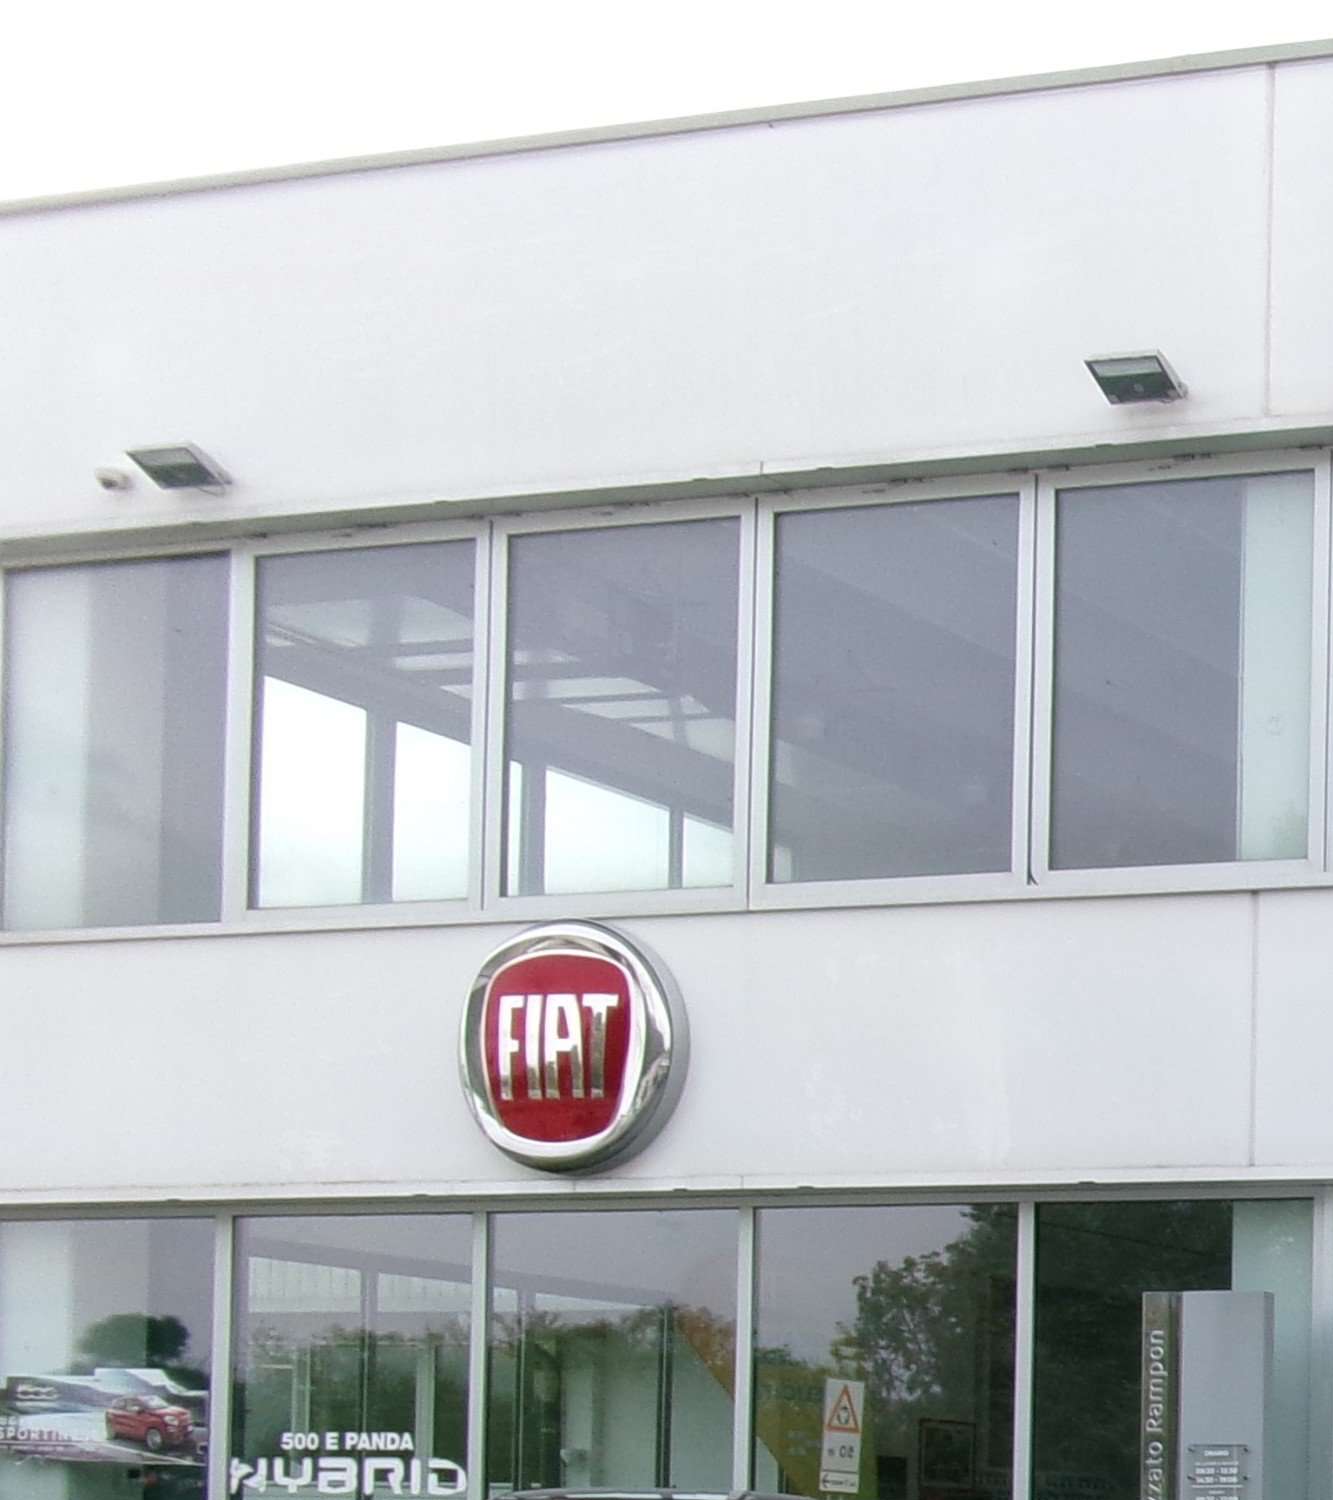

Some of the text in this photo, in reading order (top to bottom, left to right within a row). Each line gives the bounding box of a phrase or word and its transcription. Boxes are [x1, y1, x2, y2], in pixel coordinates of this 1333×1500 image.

[498, 992, 619, 1101] FIAT
[1145, 1329, 1169, 1433] Rampon
[229, 1456, 468, 1496] HYBRID
[280, 1431, 414, 1451] 500 E PANDA
